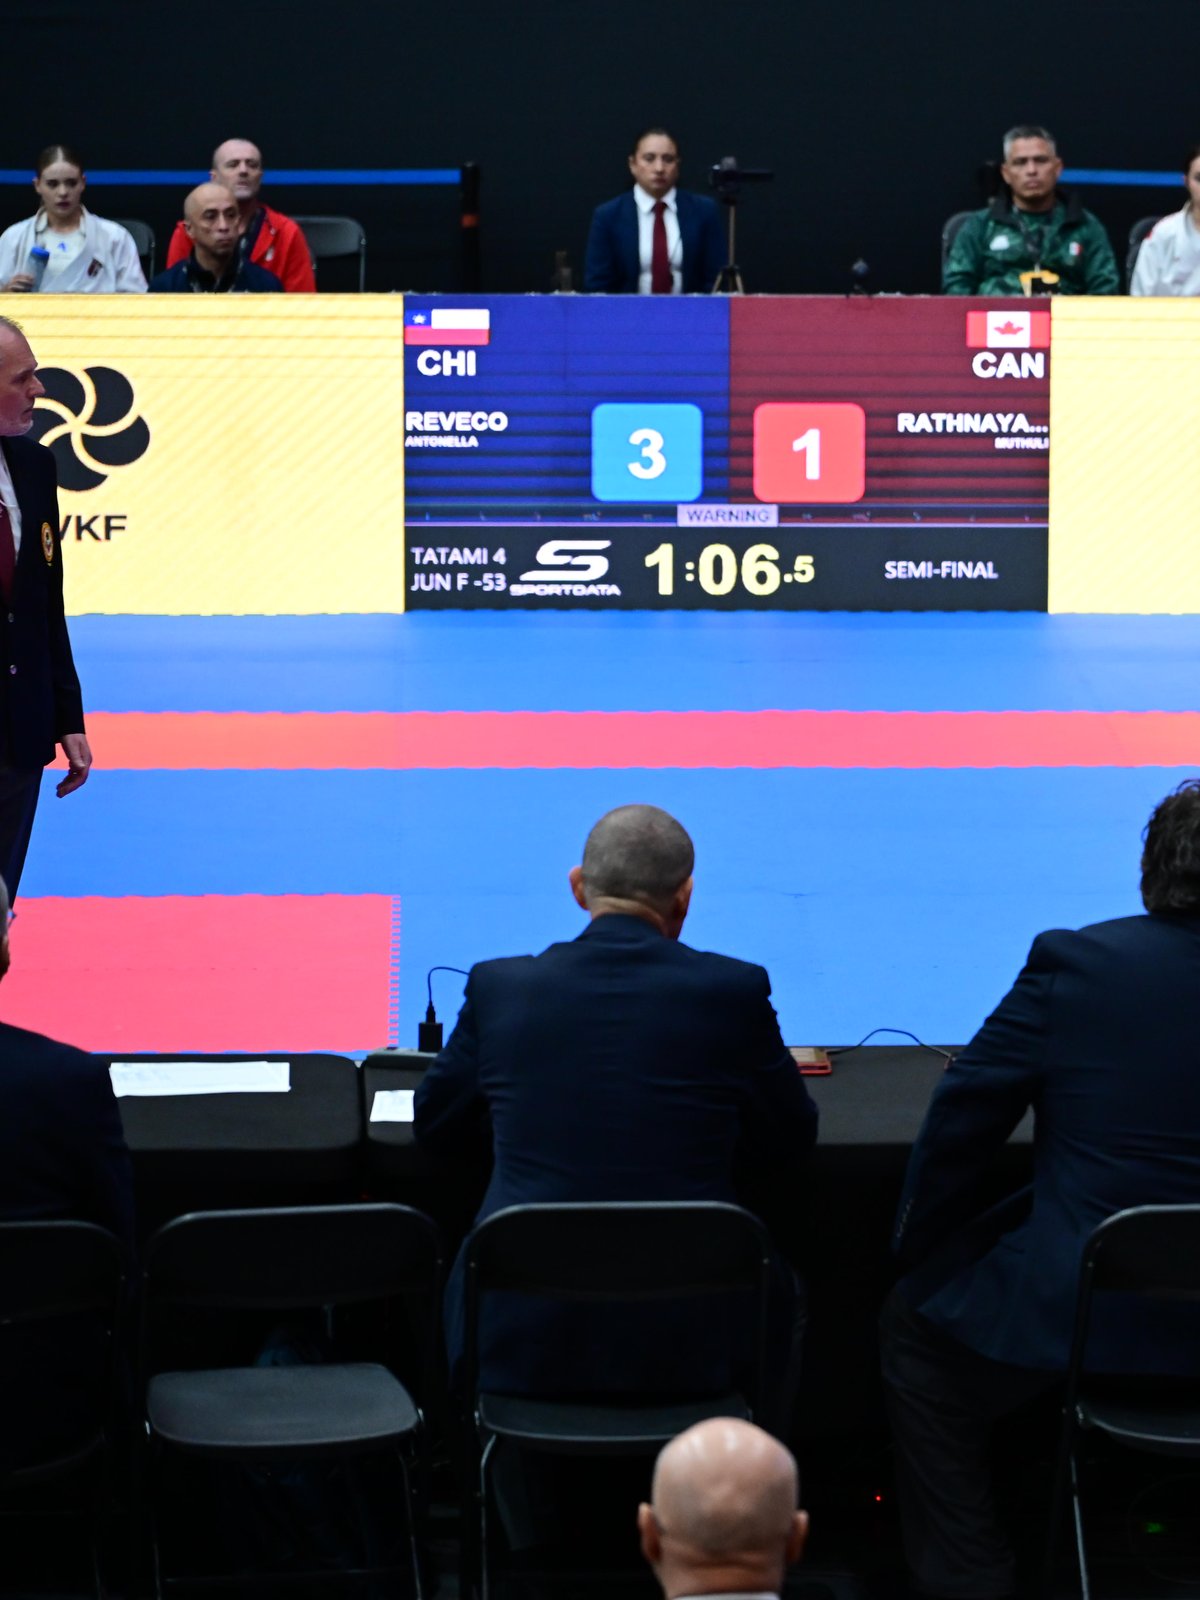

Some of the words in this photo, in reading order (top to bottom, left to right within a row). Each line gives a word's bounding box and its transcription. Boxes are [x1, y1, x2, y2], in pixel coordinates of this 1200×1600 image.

[416, 349, 477, 377] CHI
[971, 351, 1045, 379] CAN
[405, 411, 508, 432] REVECO
[627, 428, 667, 479] 3
[792, 428, 820, 480] 1
[687, 509, 770, 523] WARNING
[410, 546, 488, 565] TATAMI
[492, 547, 507, 565] 4
[884, 560, 999, 580] SEMI-FINAL
[410, 572, 452, 592] JUN
[456, 572, 470, 592] F
[473, 572, 507, 592] -53
[509, 583, 622, 597] SPORTDATA
